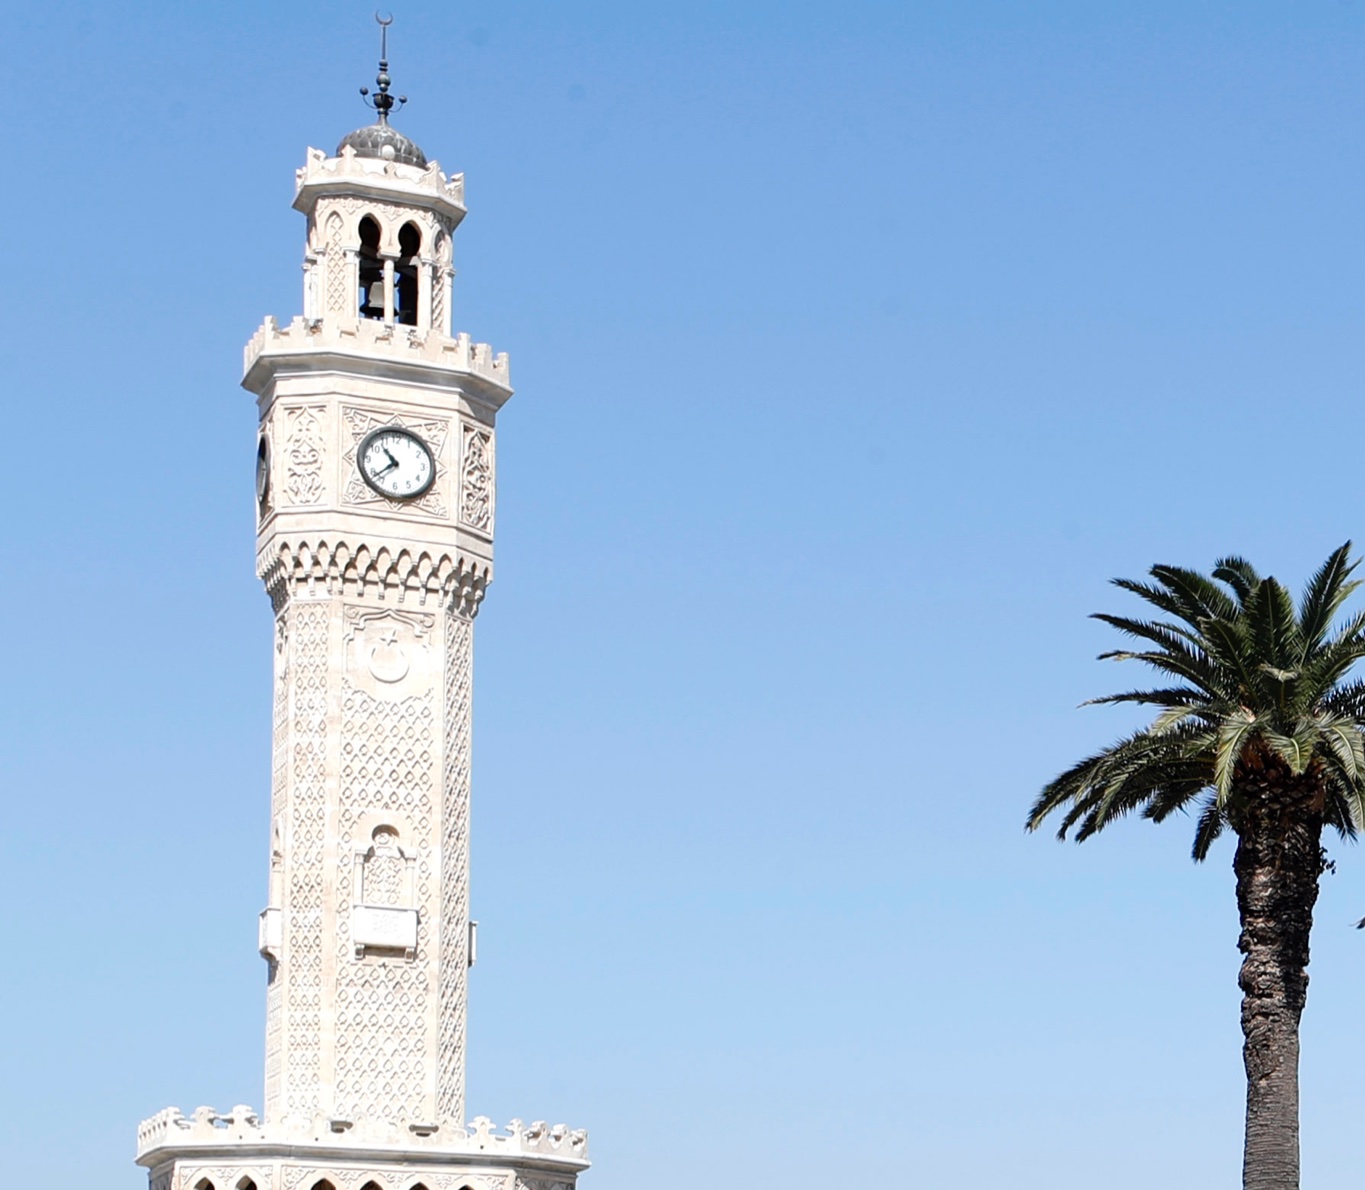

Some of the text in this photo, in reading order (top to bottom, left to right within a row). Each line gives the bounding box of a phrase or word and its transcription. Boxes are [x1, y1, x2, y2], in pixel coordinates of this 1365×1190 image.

[392, 433, 401, 445] 12
[370, 444, 380, 454] 10
[415, 450, 421, 459] 2
[365, 455, 371, 463] 9
[420, 463, 426, 471] 3
[415, 474, 421, 482] 4
[392, 482, 398, 490] 6
[406, 481, 412, 489] 5
